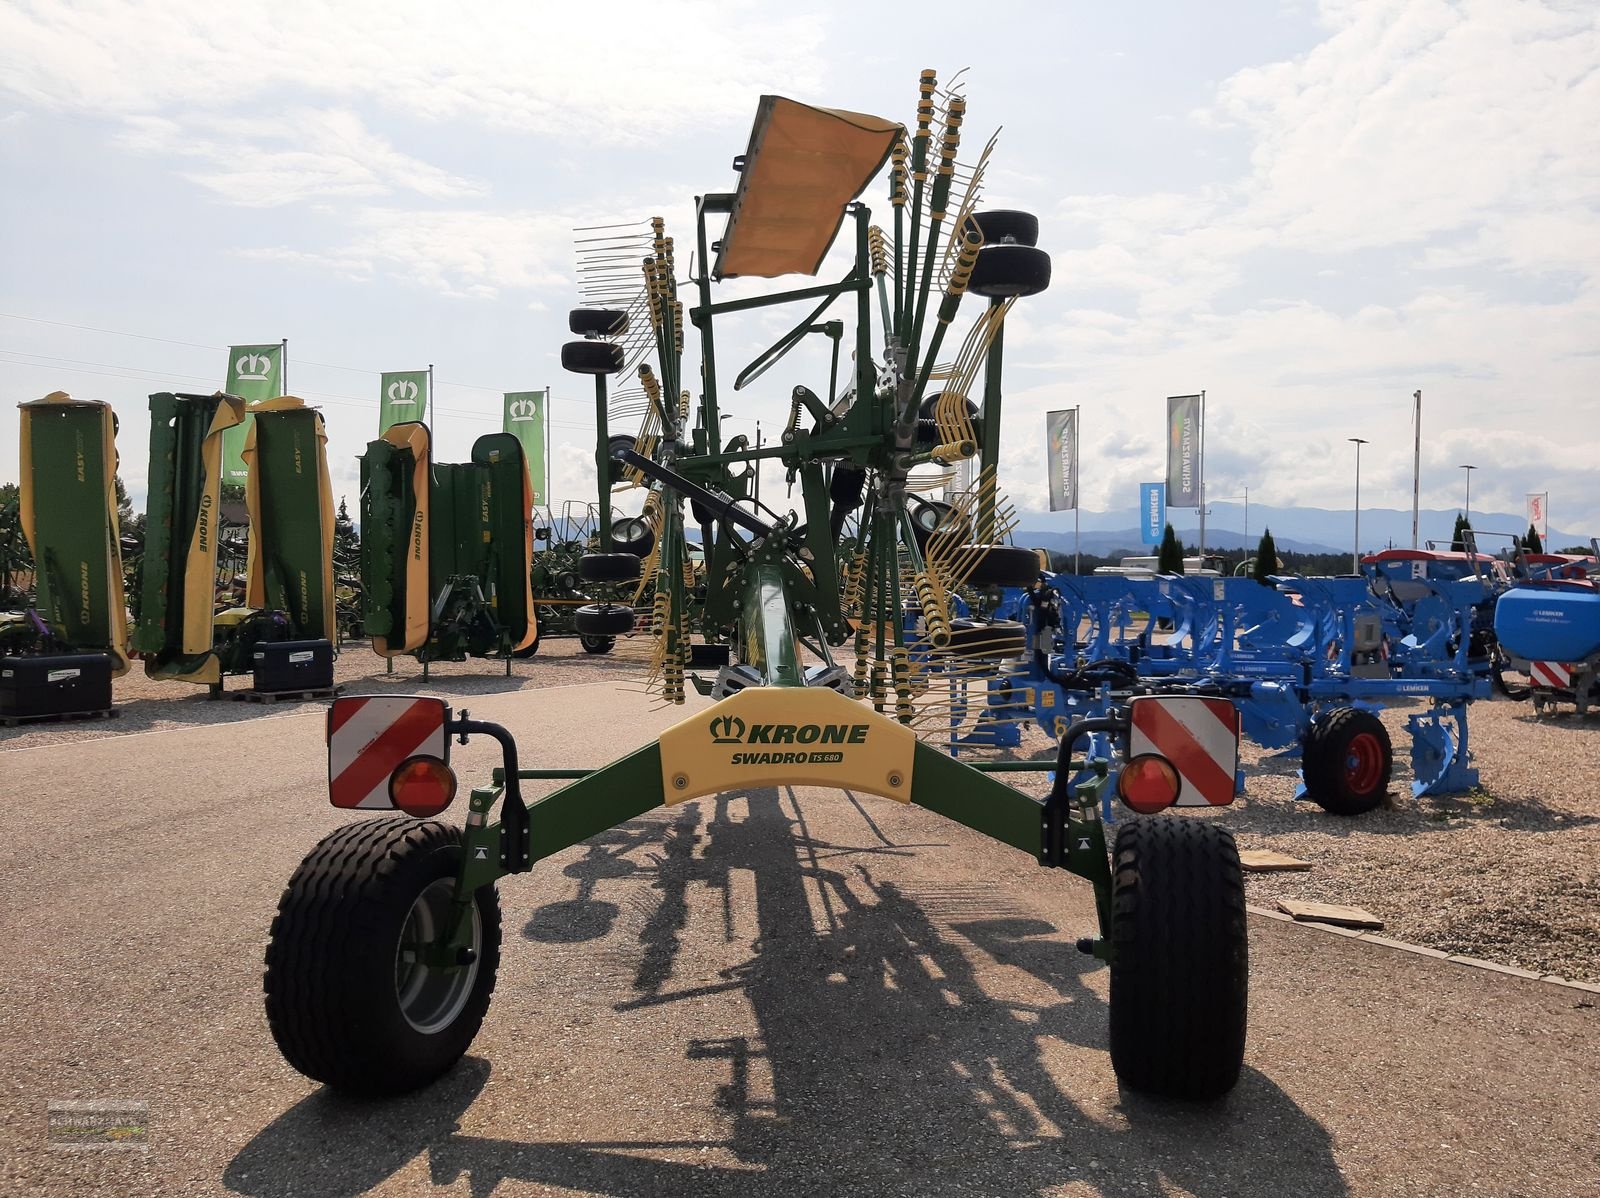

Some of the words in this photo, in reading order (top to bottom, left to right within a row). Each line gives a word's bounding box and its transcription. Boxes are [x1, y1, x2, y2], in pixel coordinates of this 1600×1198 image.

[200, 510, 208, 553] KRONE
[414, 521, 422, 561] KRONE
[747, 724, 870, 744] KRONE
[731, 752, 807, 765] SWADRO
[812, 753, 823, 762] TS
[823, 753, 840, 762] 680
